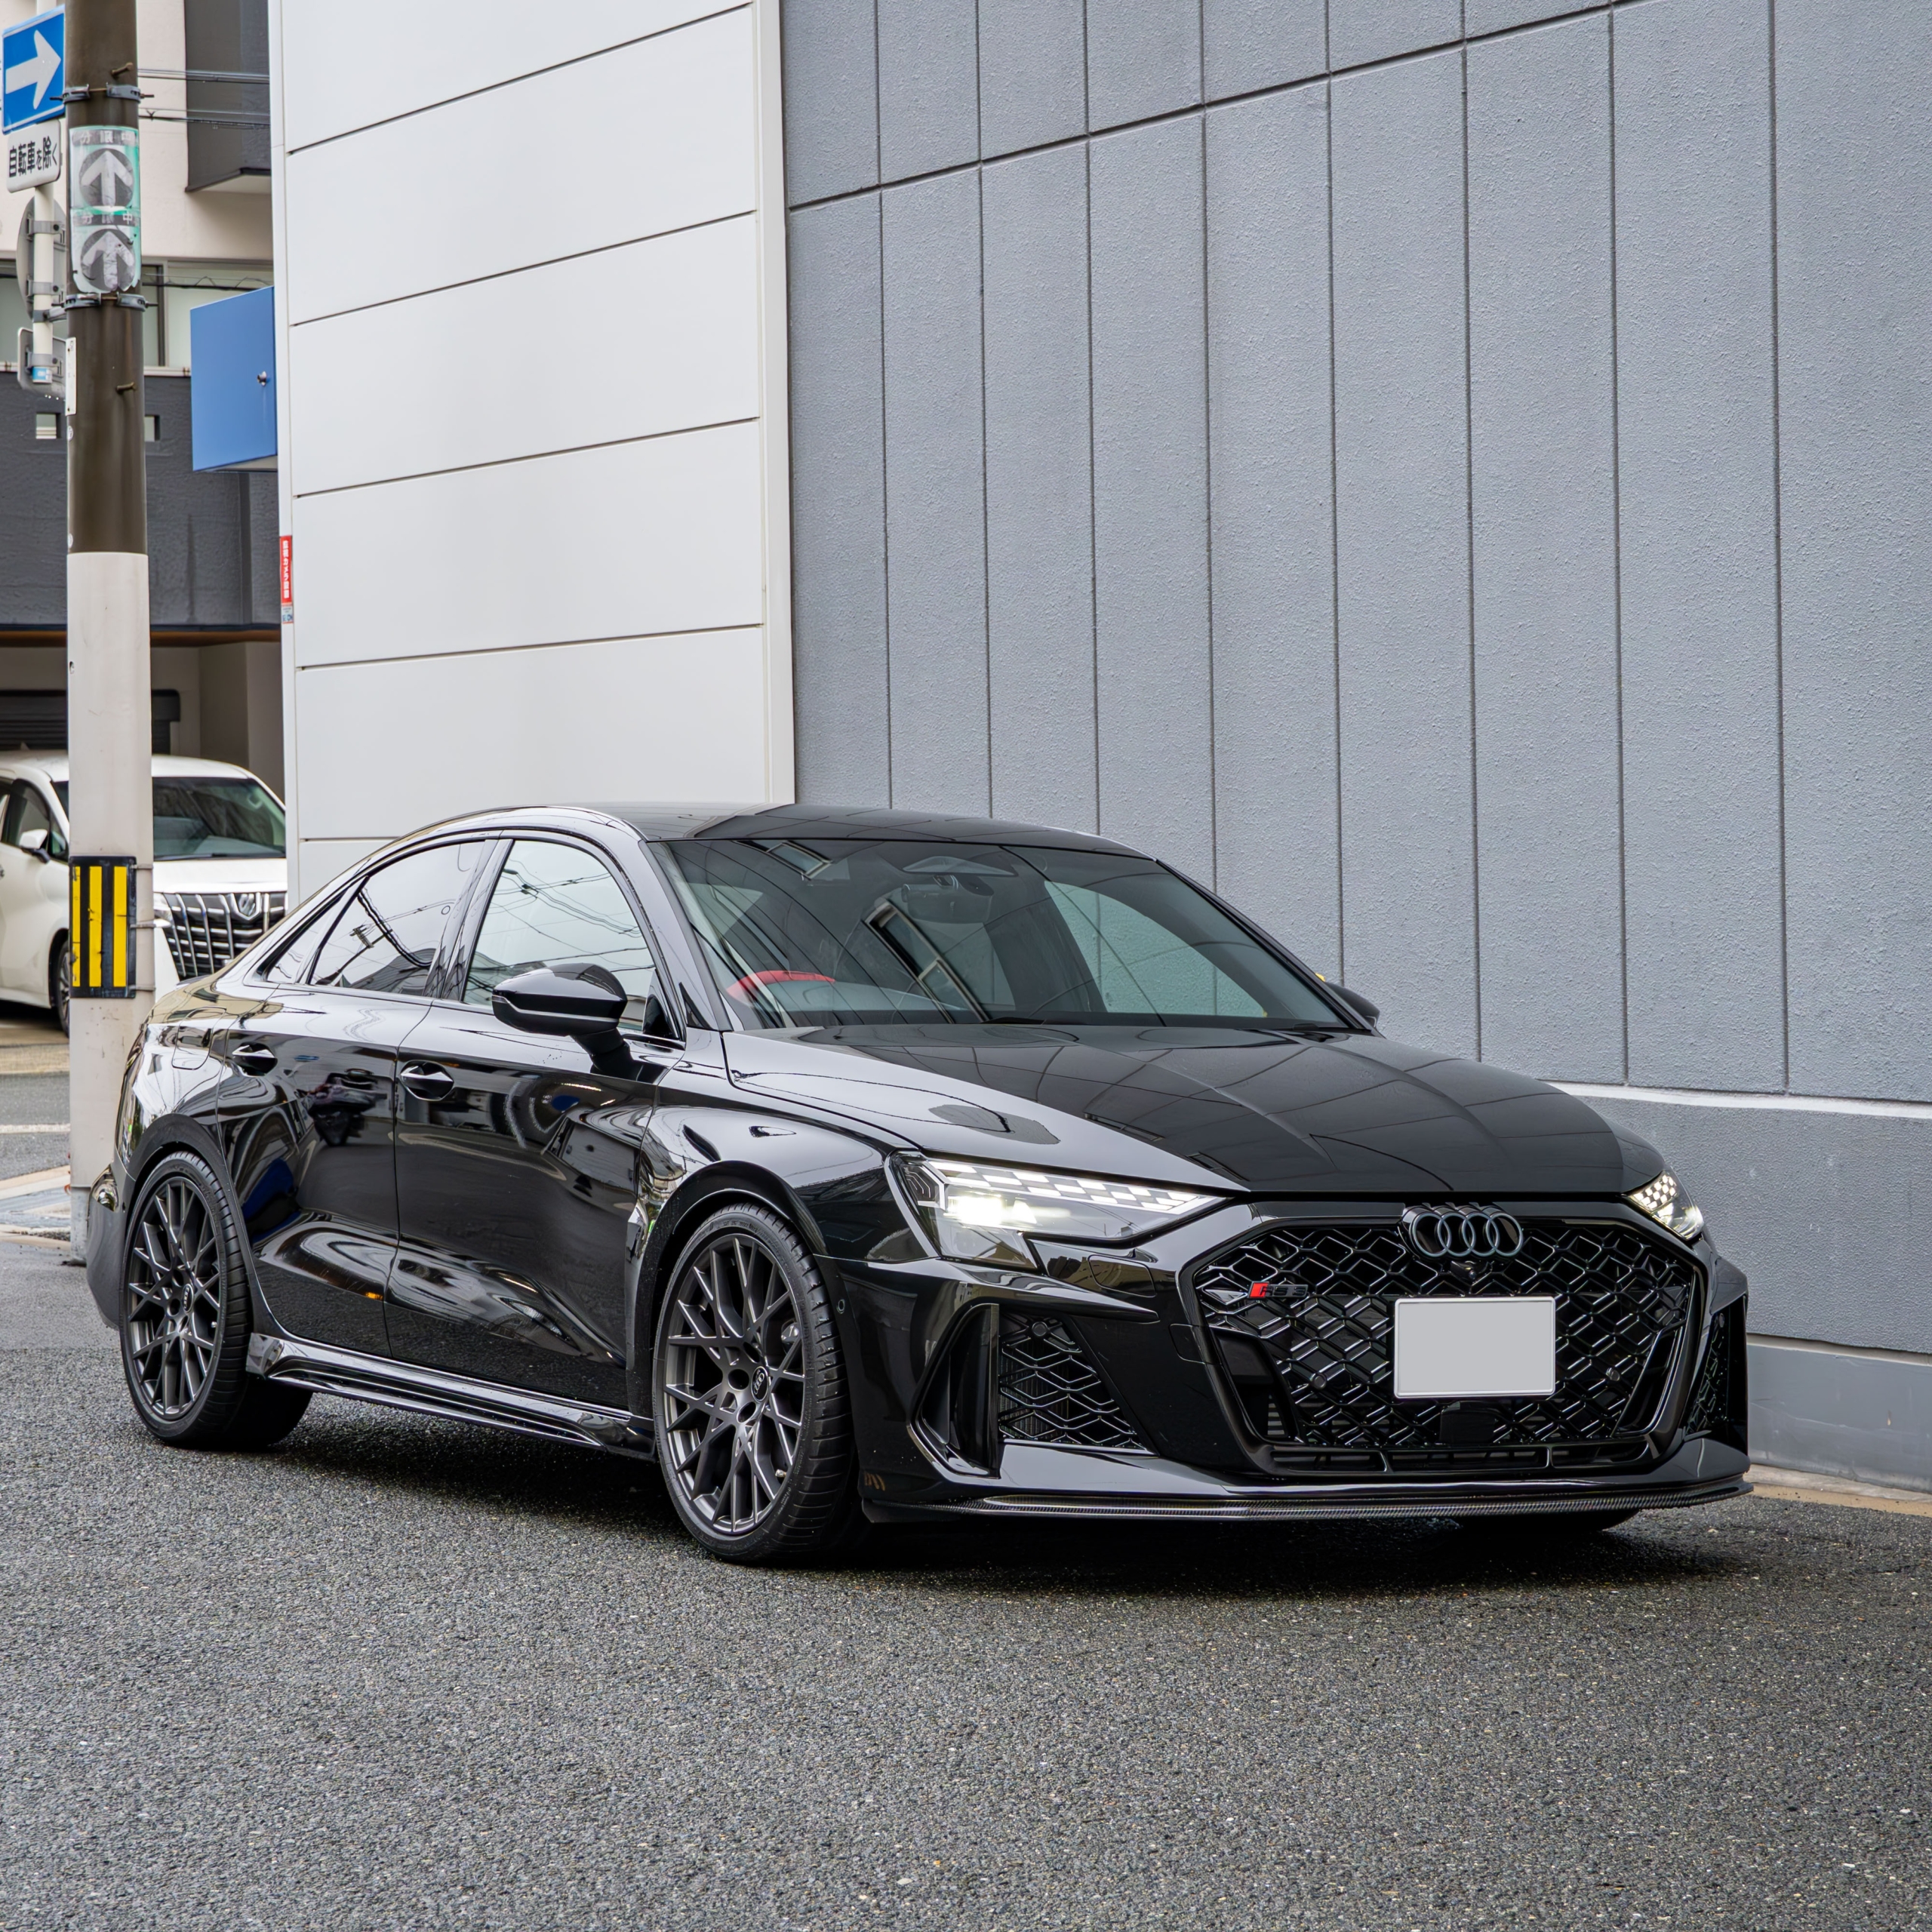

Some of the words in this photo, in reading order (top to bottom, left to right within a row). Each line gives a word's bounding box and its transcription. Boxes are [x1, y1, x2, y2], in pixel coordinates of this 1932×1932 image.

[9, 136, 57, 177] 自転車を除く
